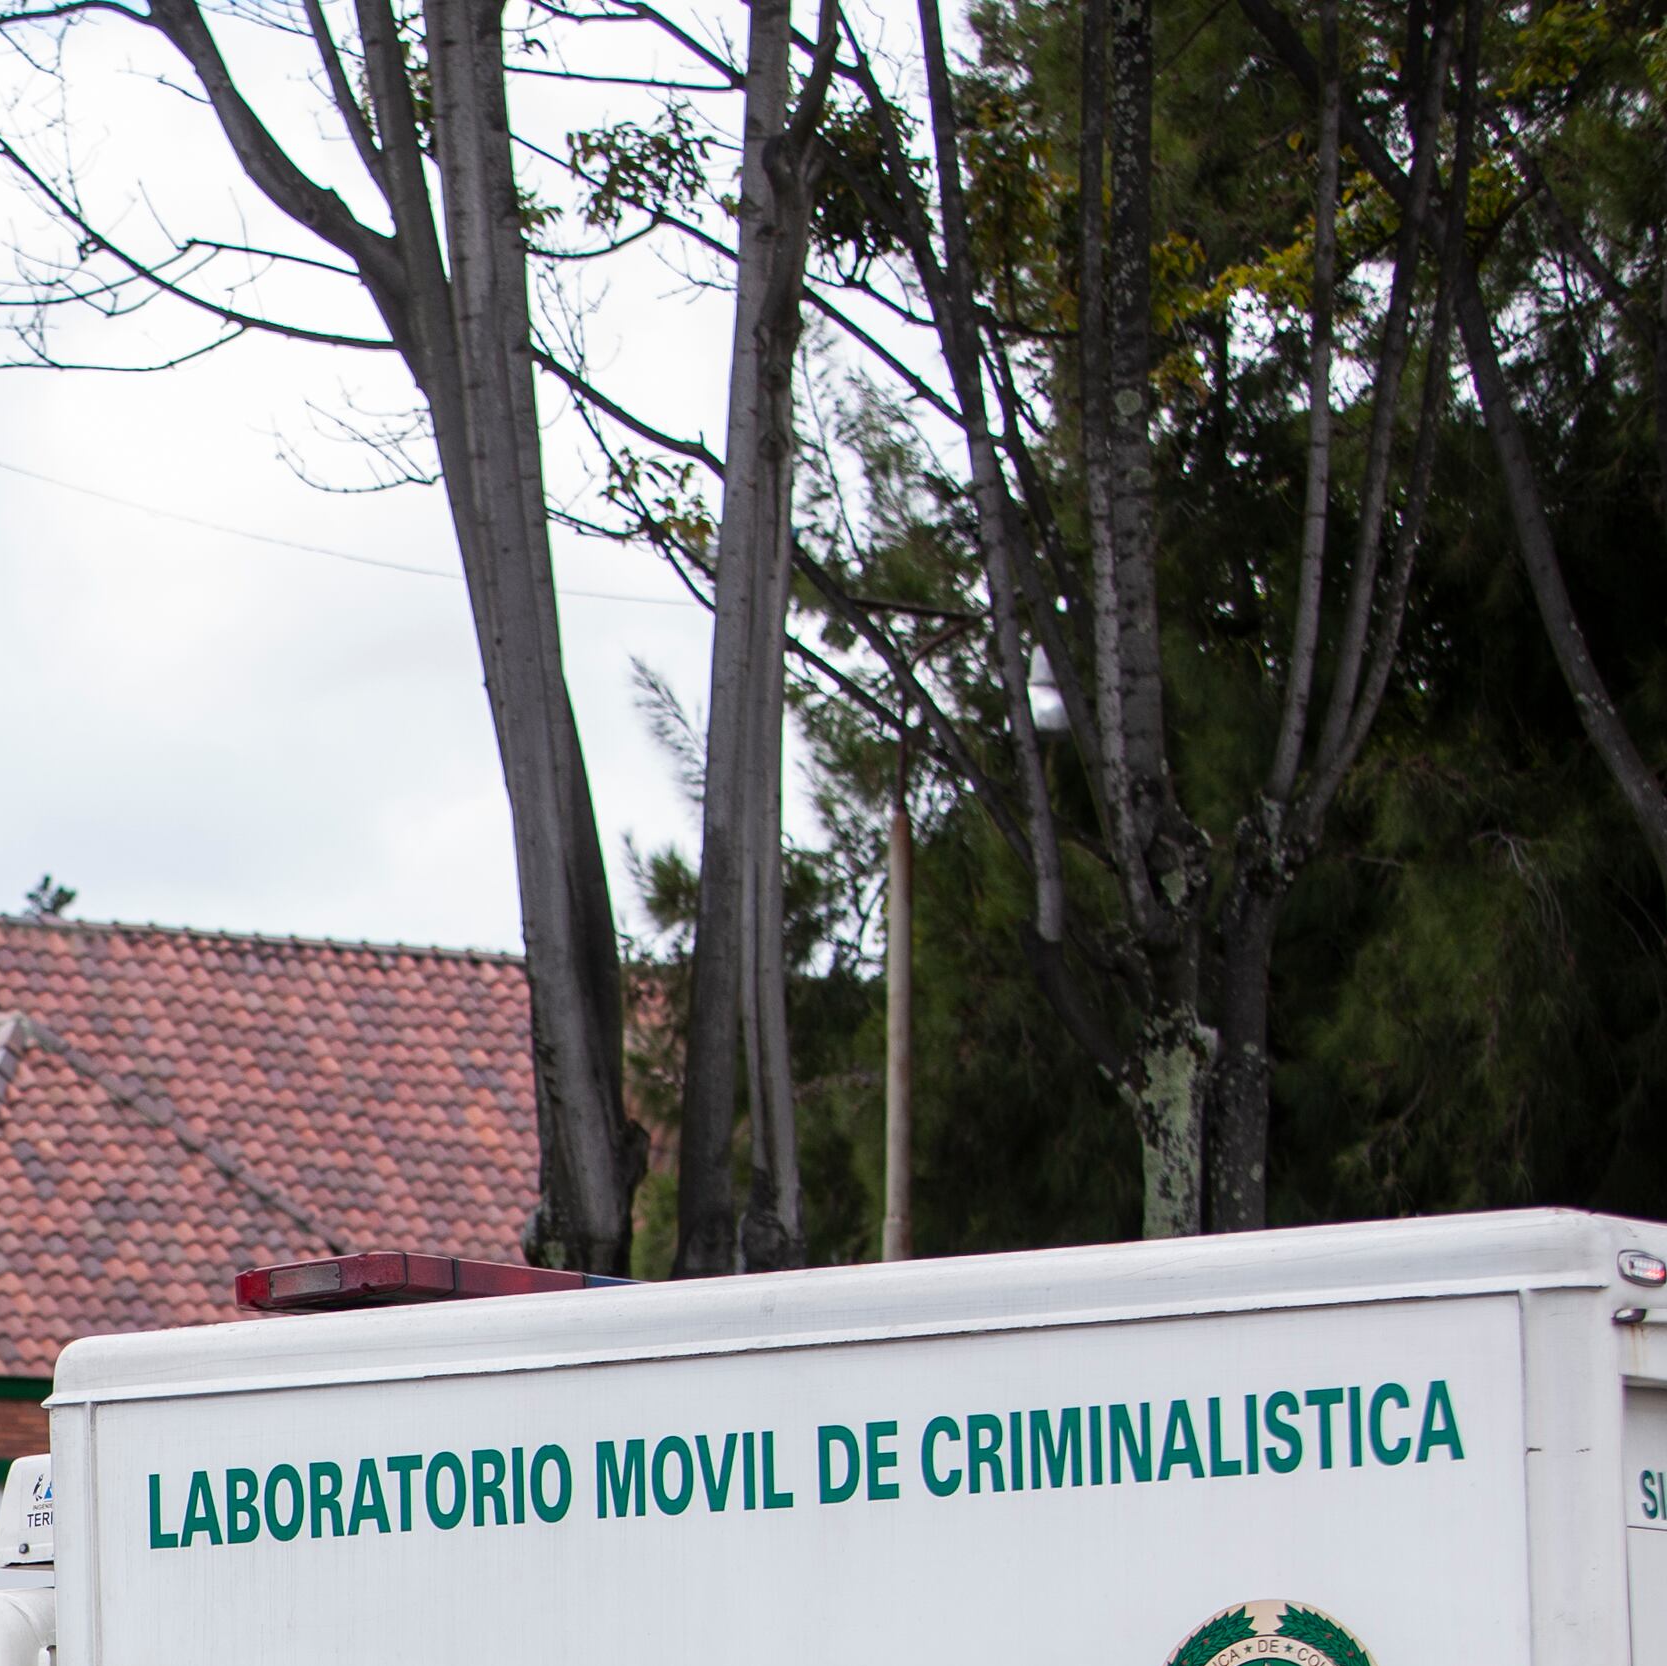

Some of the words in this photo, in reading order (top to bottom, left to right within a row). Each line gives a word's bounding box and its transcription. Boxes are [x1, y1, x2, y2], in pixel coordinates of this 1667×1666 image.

[148, 1443, 573, 1550] LABORATORIO
[595, 1430, 794, 1519] MOVIL
[817, 1420, 900, 1505] DE
[921, 1379, 1465, 1499] CRIMINALISTICA
[1257, 1639, 1280, 1654] DE
